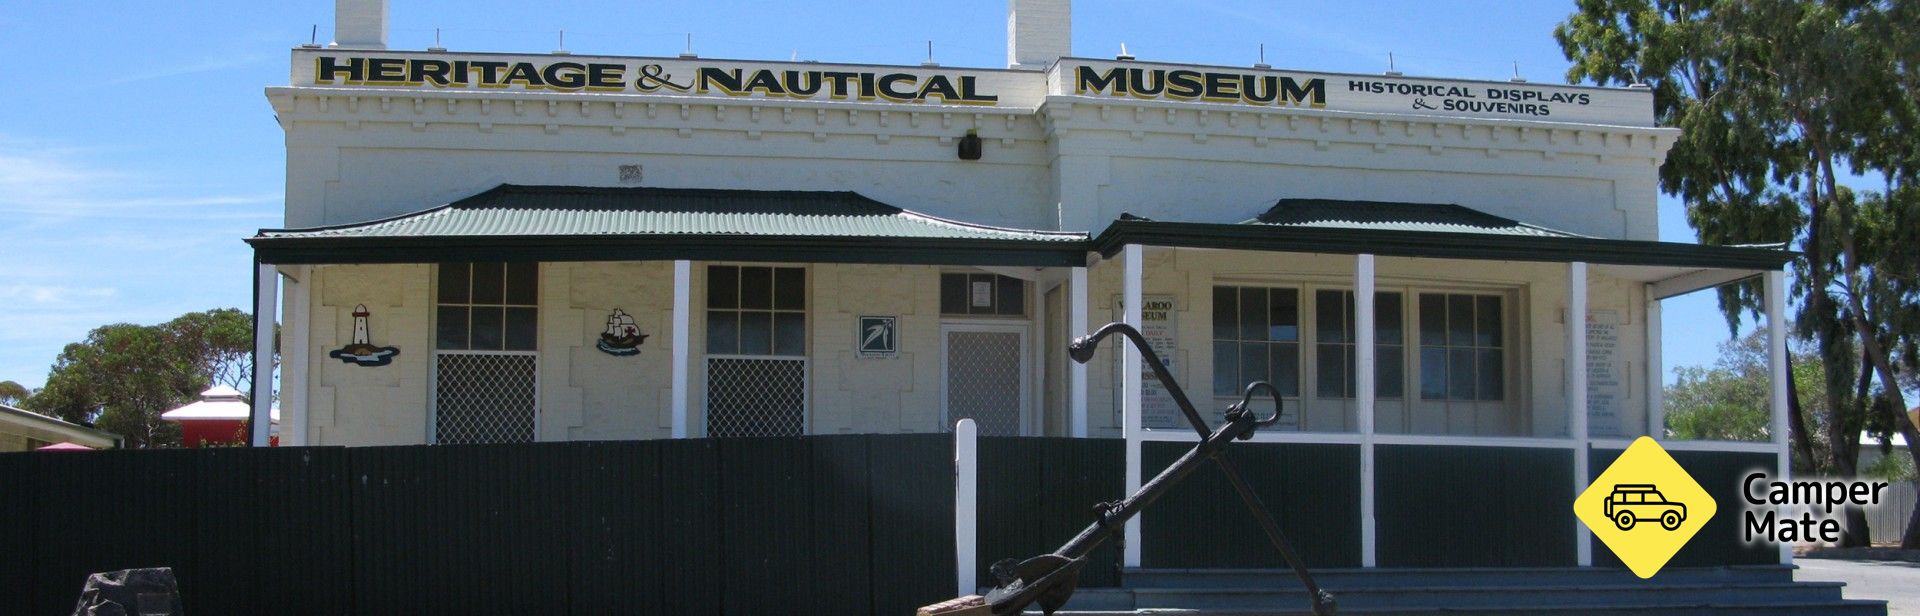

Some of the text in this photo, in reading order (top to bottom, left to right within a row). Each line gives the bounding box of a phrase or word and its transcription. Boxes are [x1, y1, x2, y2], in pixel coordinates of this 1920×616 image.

[315, 56, 1327, 108] HERITAGE & NAUTICAL MUSEUM
[1348, 80, 1591, 106] HISTORICAL DISPLAYS
[1412, 98, 1551, 116] & SOUVENIRS
